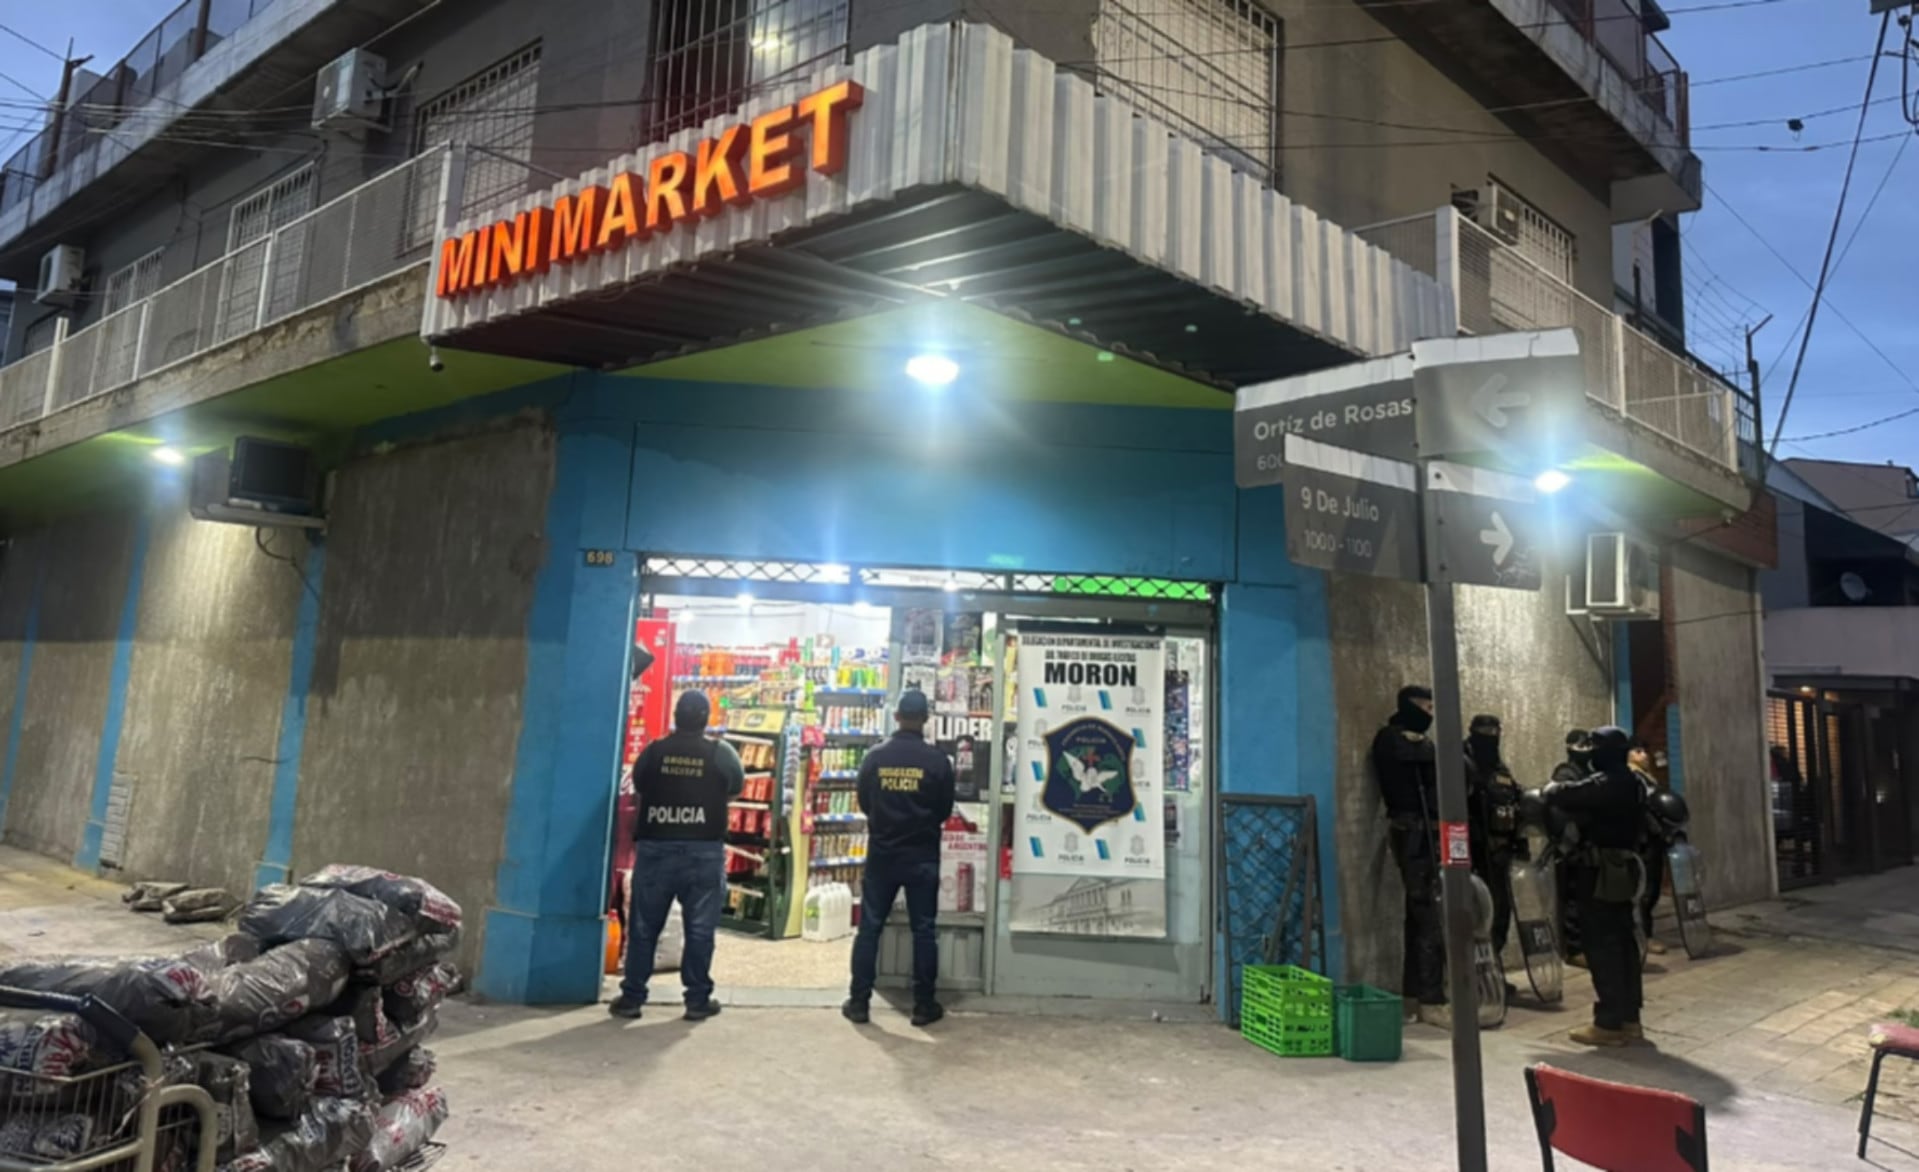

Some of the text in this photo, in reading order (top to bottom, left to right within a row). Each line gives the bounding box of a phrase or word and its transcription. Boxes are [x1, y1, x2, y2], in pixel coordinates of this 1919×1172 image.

[436, 79, 864, 298] MINI MARKET
[1310, 410, 1337, 430] de
[1344, 398, 1413, 425] Rosas
[1301, 486, 1379, 522] 9 De Julio
[1304, 530, 1336, 552] 1000
[1044, 662, 1137, 686] MORON
[880, 778, 919, 792] POLICIA
[647, 806, 706, 824] POLICIA
[1124, 856, 1151, 865] POLICIA
